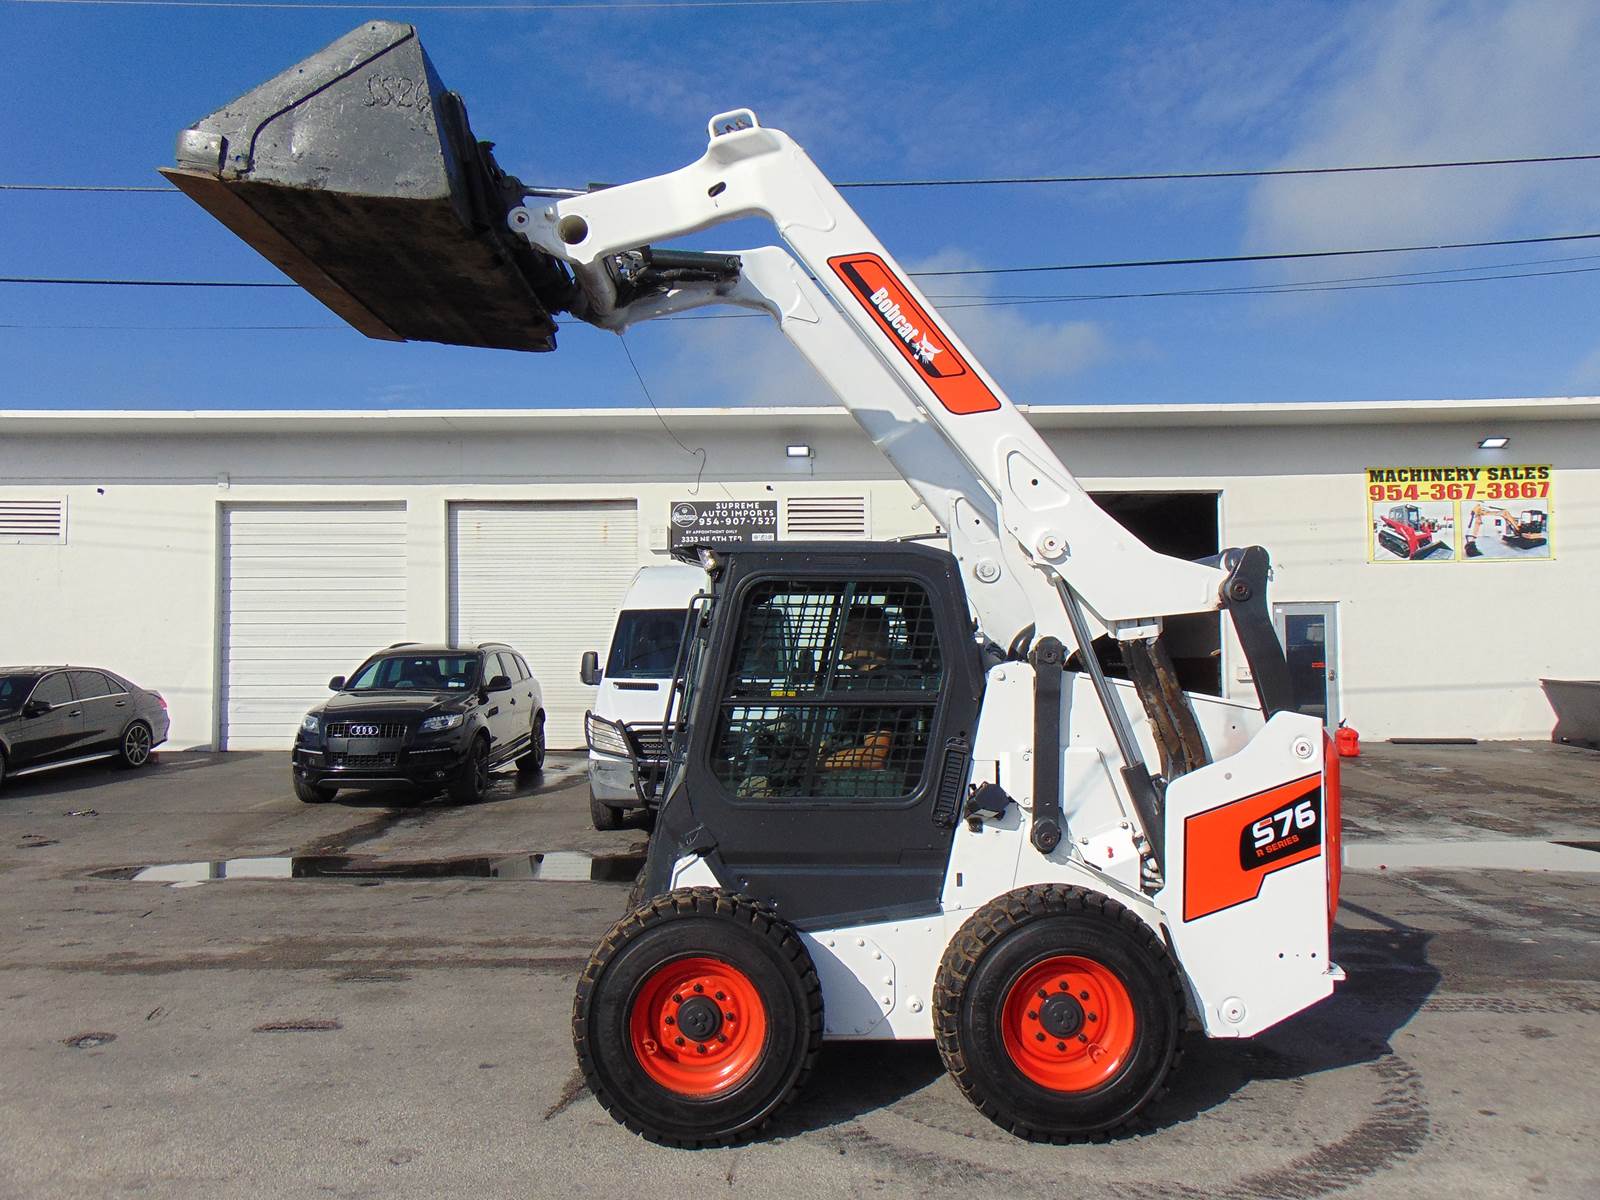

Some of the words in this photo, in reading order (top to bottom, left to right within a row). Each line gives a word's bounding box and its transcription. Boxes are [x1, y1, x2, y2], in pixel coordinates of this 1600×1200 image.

[869, 287, 919, 343] Bobcat
[1369, 467, 1480, 482] MACHINERY
[1488, 466, 1549, 480] SALES
[1369, 482, 1550, 500] 954-367-3867
[699, 517, 776, 525] 954-907-7527
[731, 509, 774, 517] IMPORTS
[1252, 800, 1316, 849] S76
[1256, 848, 1265, 857] R
[1265, 834, 1300, 853] SERIES
